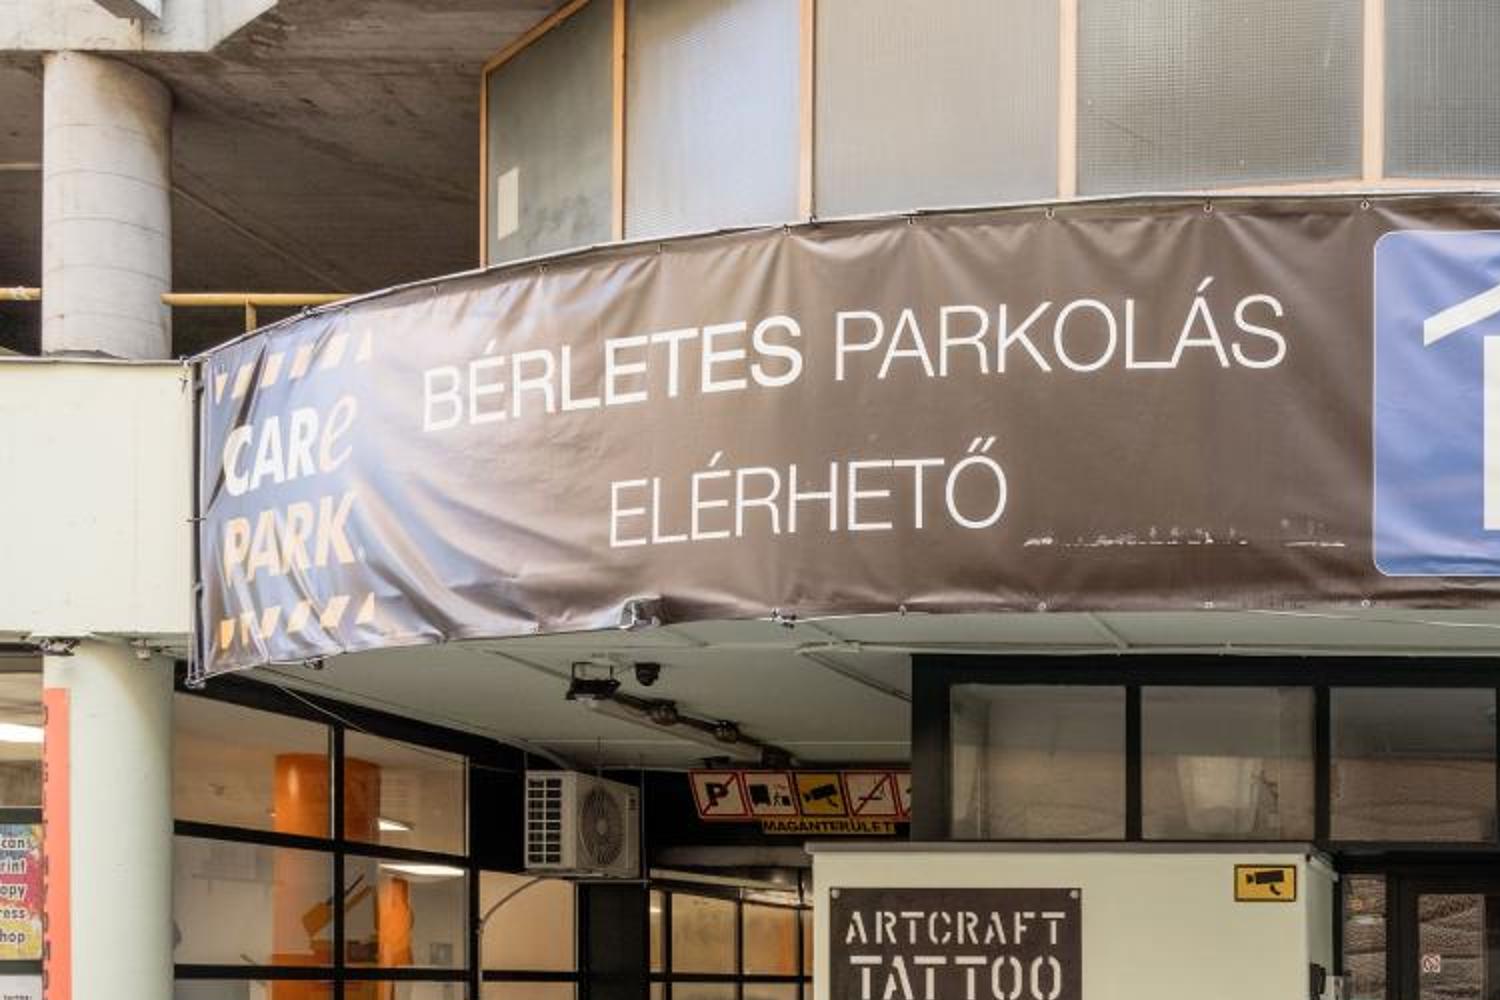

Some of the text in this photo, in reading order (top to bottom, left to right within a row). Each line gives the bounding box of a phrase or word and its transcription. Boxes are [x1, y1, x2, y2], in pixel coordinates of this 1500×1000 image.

[423, 276, 1288, 433] BÉRLETES PARKOLÁS
[223, 489, 357, 588] PARK
[609, 436, 1007, 549] ELÉRHETŐ
[844, 910, 1067, 945] ARTCRAFT
[849, 955, 1063, 1000] TATTOO
